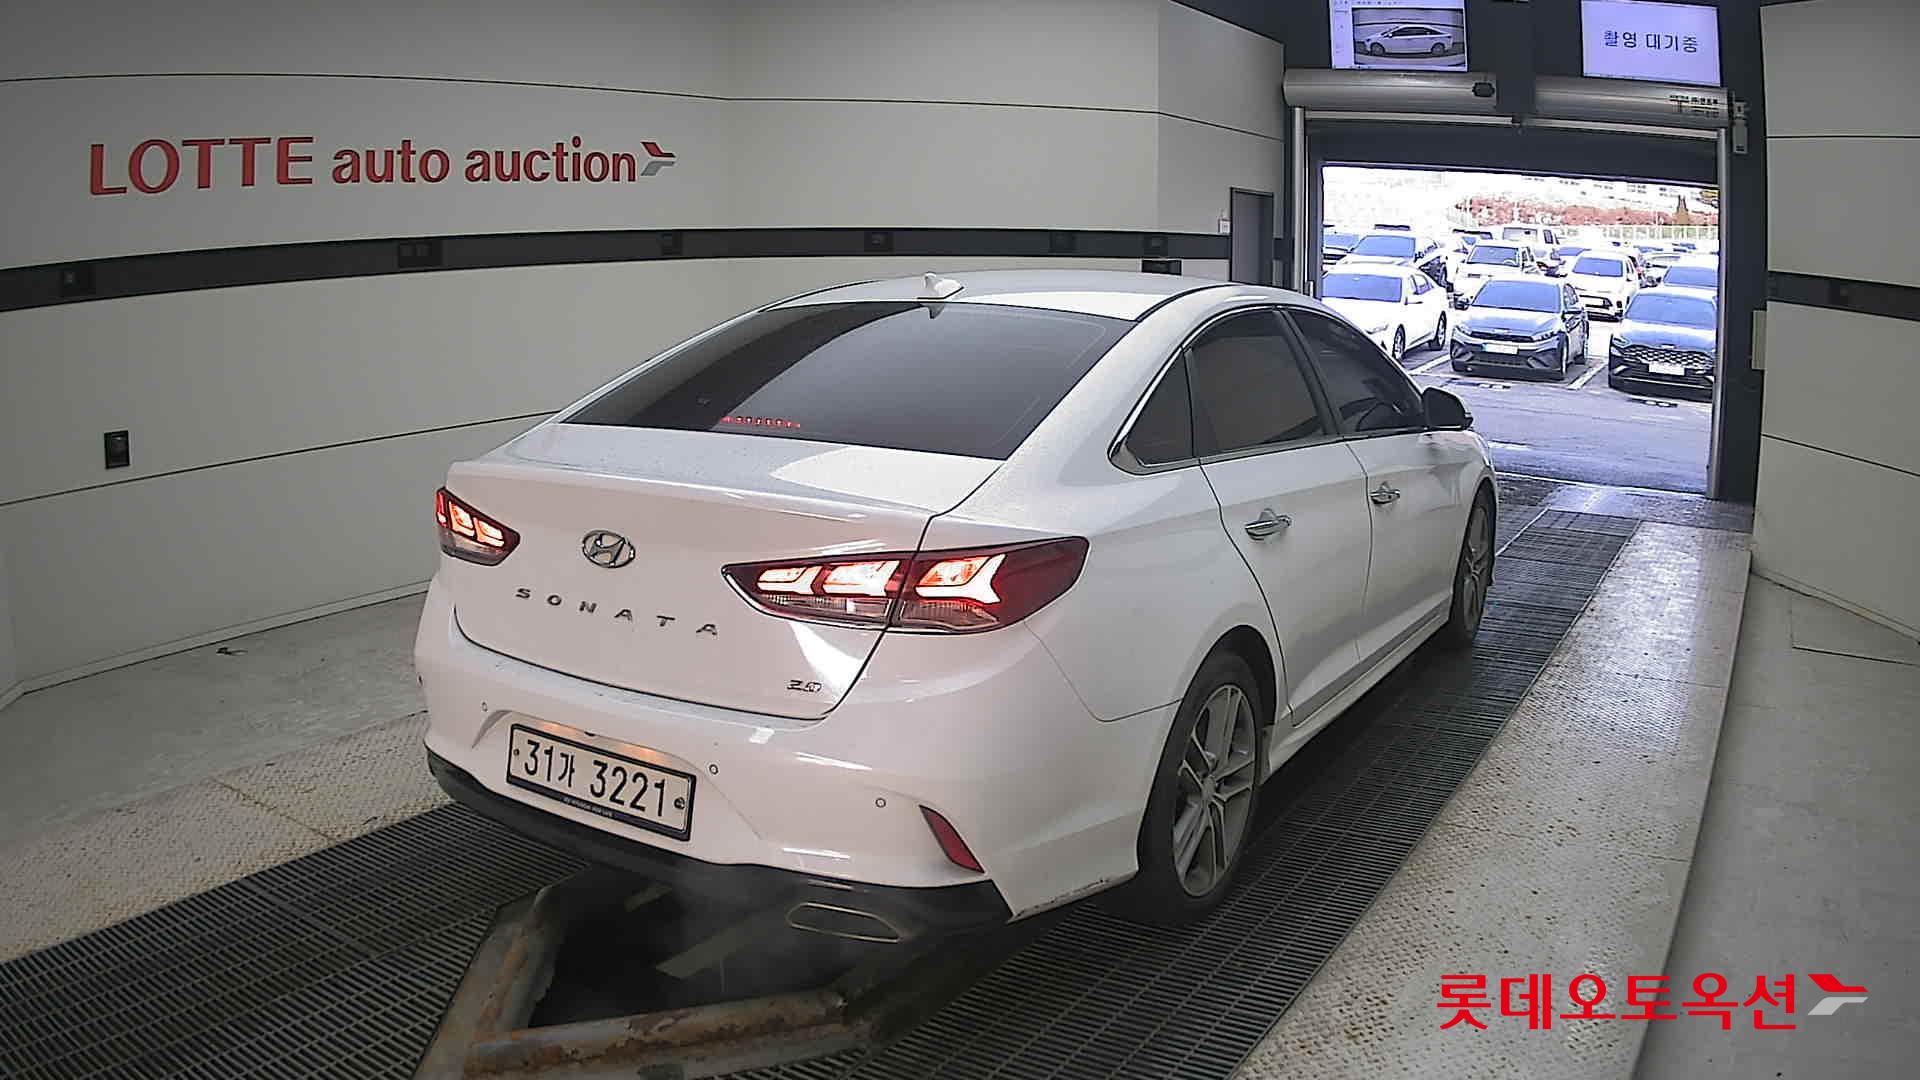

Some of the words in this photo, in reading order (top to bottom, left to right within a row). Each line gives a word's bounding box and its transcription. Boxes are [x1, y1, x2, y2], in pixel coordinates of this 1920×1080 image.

[1603, 29, 1638, 49] 촬영
[1645, 33, 1699, 53] 대기중
[90, 136, 314, 196] LOTTE
[331, 139, 450, 184] auto
[464, 136, 637, 183] auction
[515, 587, 718, 636] SONATA
[524, 739, 576, 788] 31가
[589, 759, 666, 817] 3221
